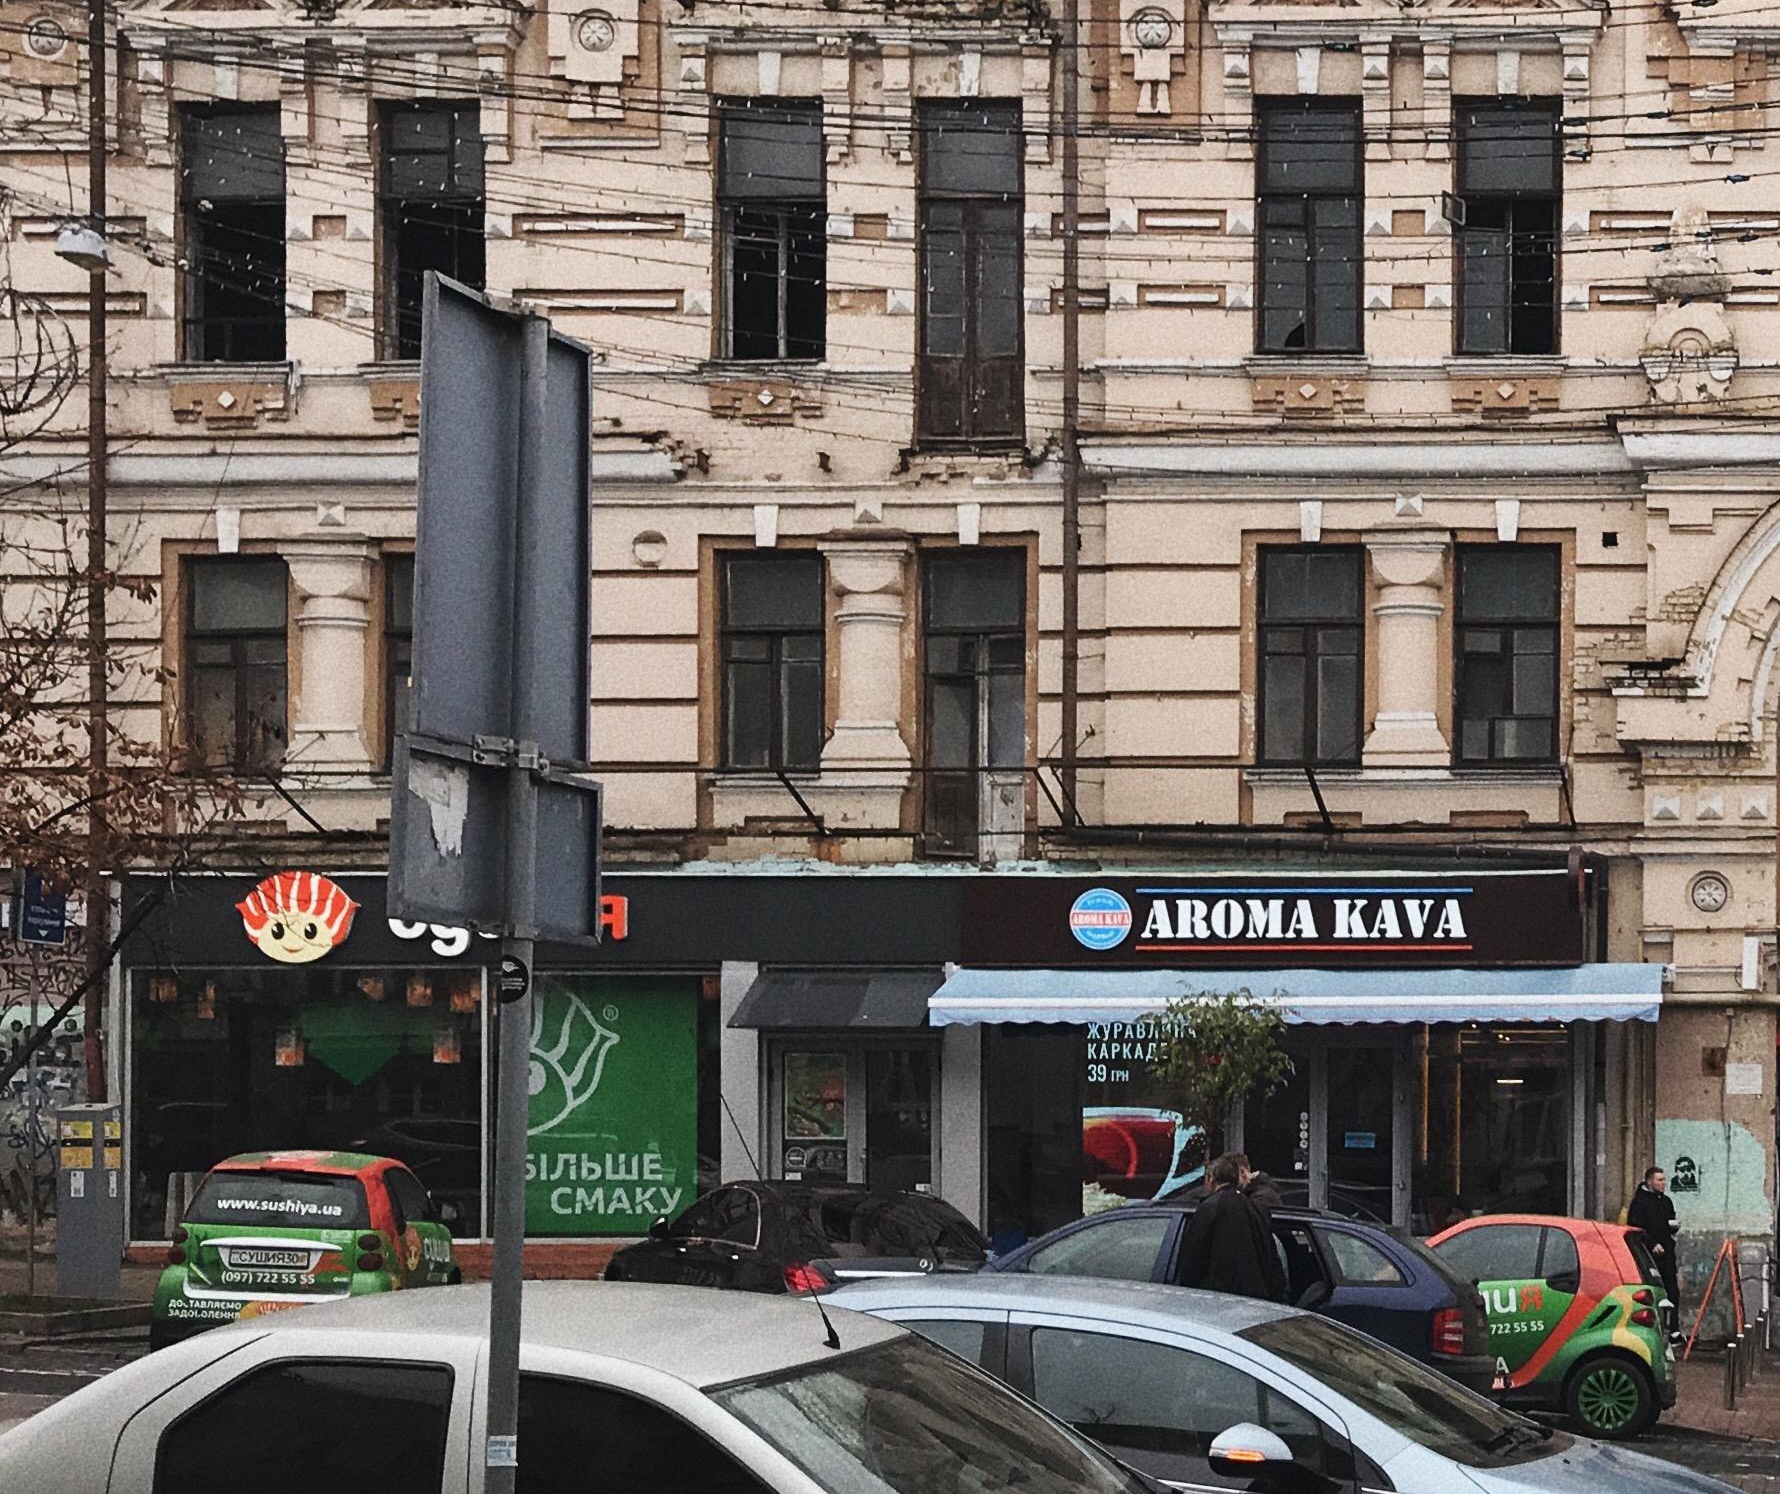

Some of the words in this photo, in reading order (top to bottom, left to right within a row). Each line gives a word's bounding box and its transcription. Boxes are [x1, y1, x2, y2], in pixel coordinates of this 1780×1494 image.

[1140, 899, 1319, 938] AROMA
[1333, 899, 1467, 938] KAVA
[1087, 1064, 1107, 1082] 39
[1111, 1070, 1129, 1082] ГРН
[217, 1198, 343, 1217] www.sushiya.ua
[551, 1187, 683, 1215] СМАКУ
[221, 1271, 252, 1284] (097)
[256, 1273, 278, 1284] 722
[281, 1274, 297, 1284] 55
[300, 1274, 316, 1285] 55
[1490, 1323, 1511, 1335] 722
[1513, 1321, 1527, 1333] 55
[1530, 1320, 1544, 1332] 55
